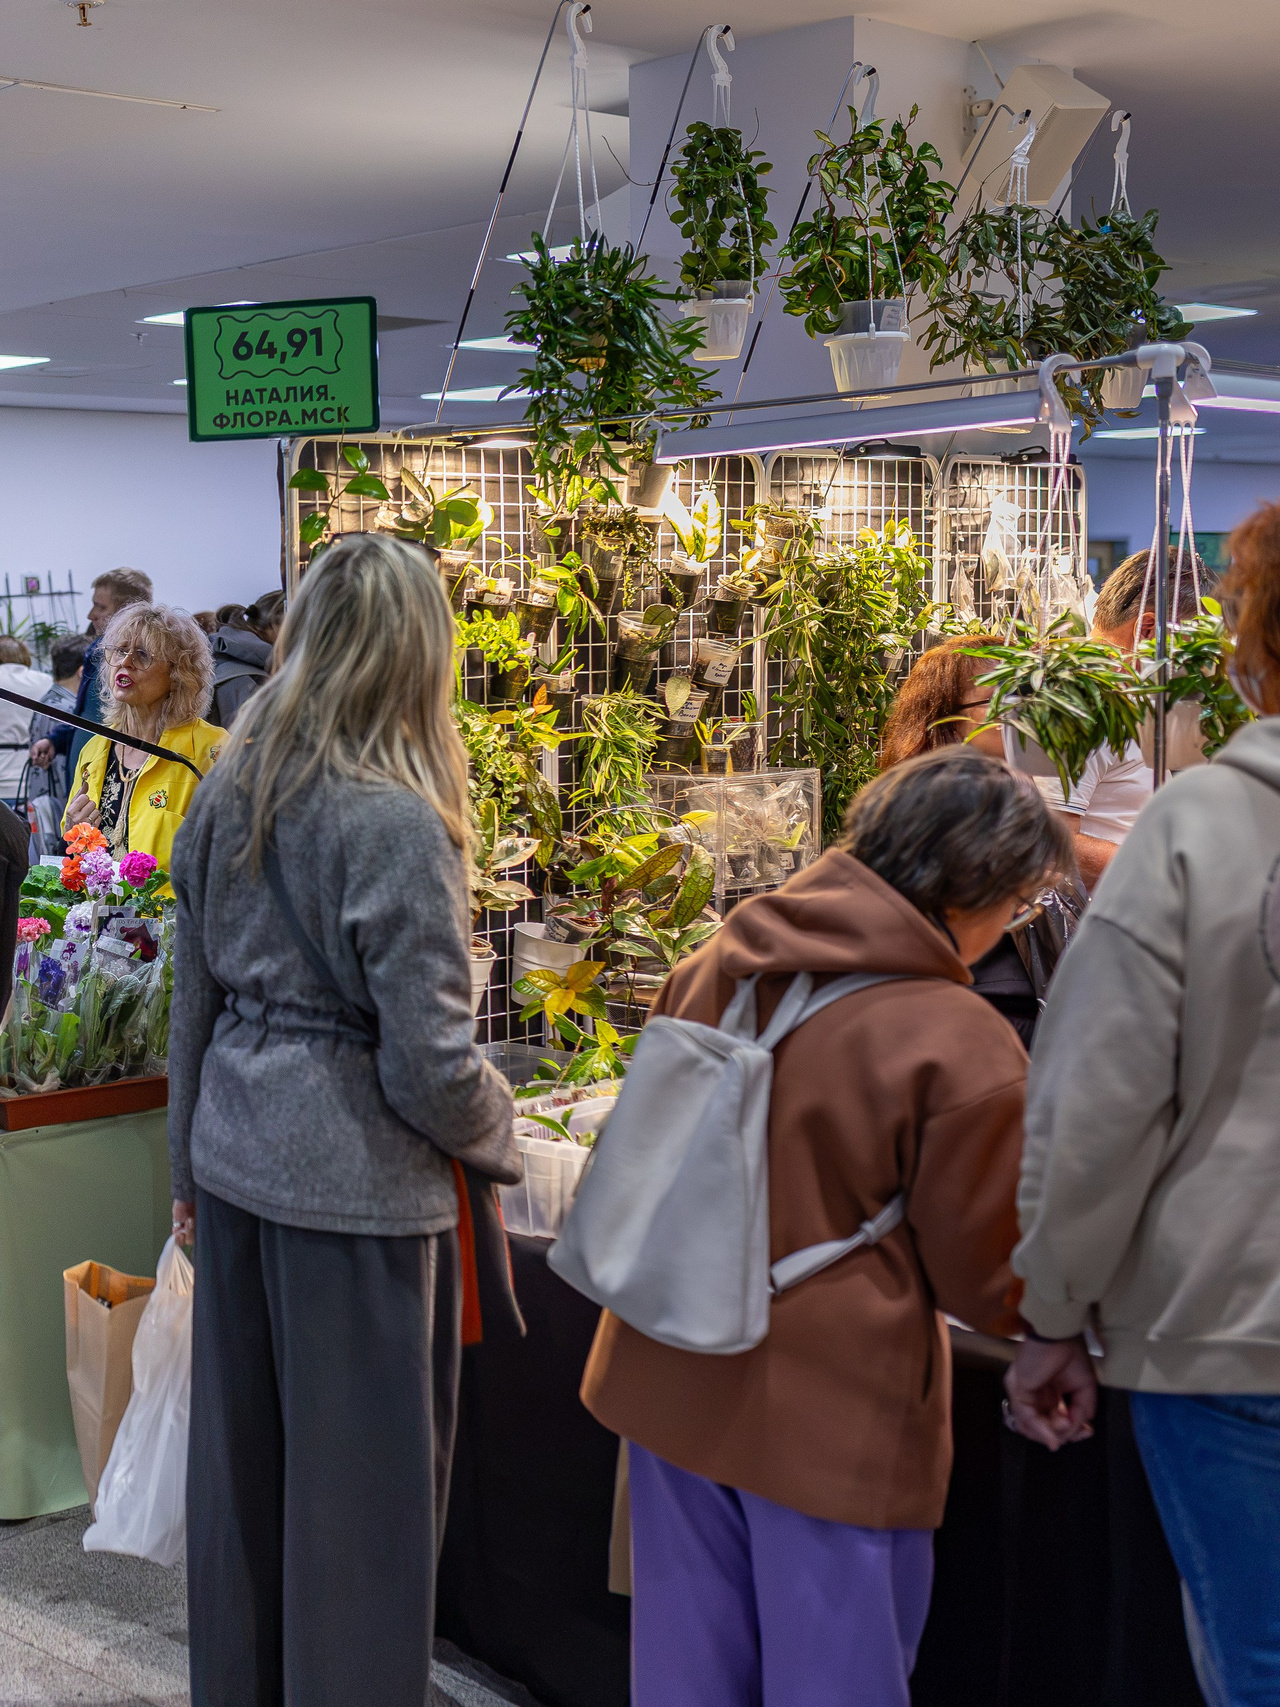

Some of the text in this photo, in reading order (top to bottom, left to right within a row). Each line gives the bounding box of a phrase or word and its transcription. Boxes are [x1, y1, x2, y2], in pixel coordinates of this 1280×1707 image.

[232, 327, 323, 364] 64,91
[226, 384, 336, 406] НАТАЛИЯ.
[212, 406, 350, 429] ФЛОРА.МСК
